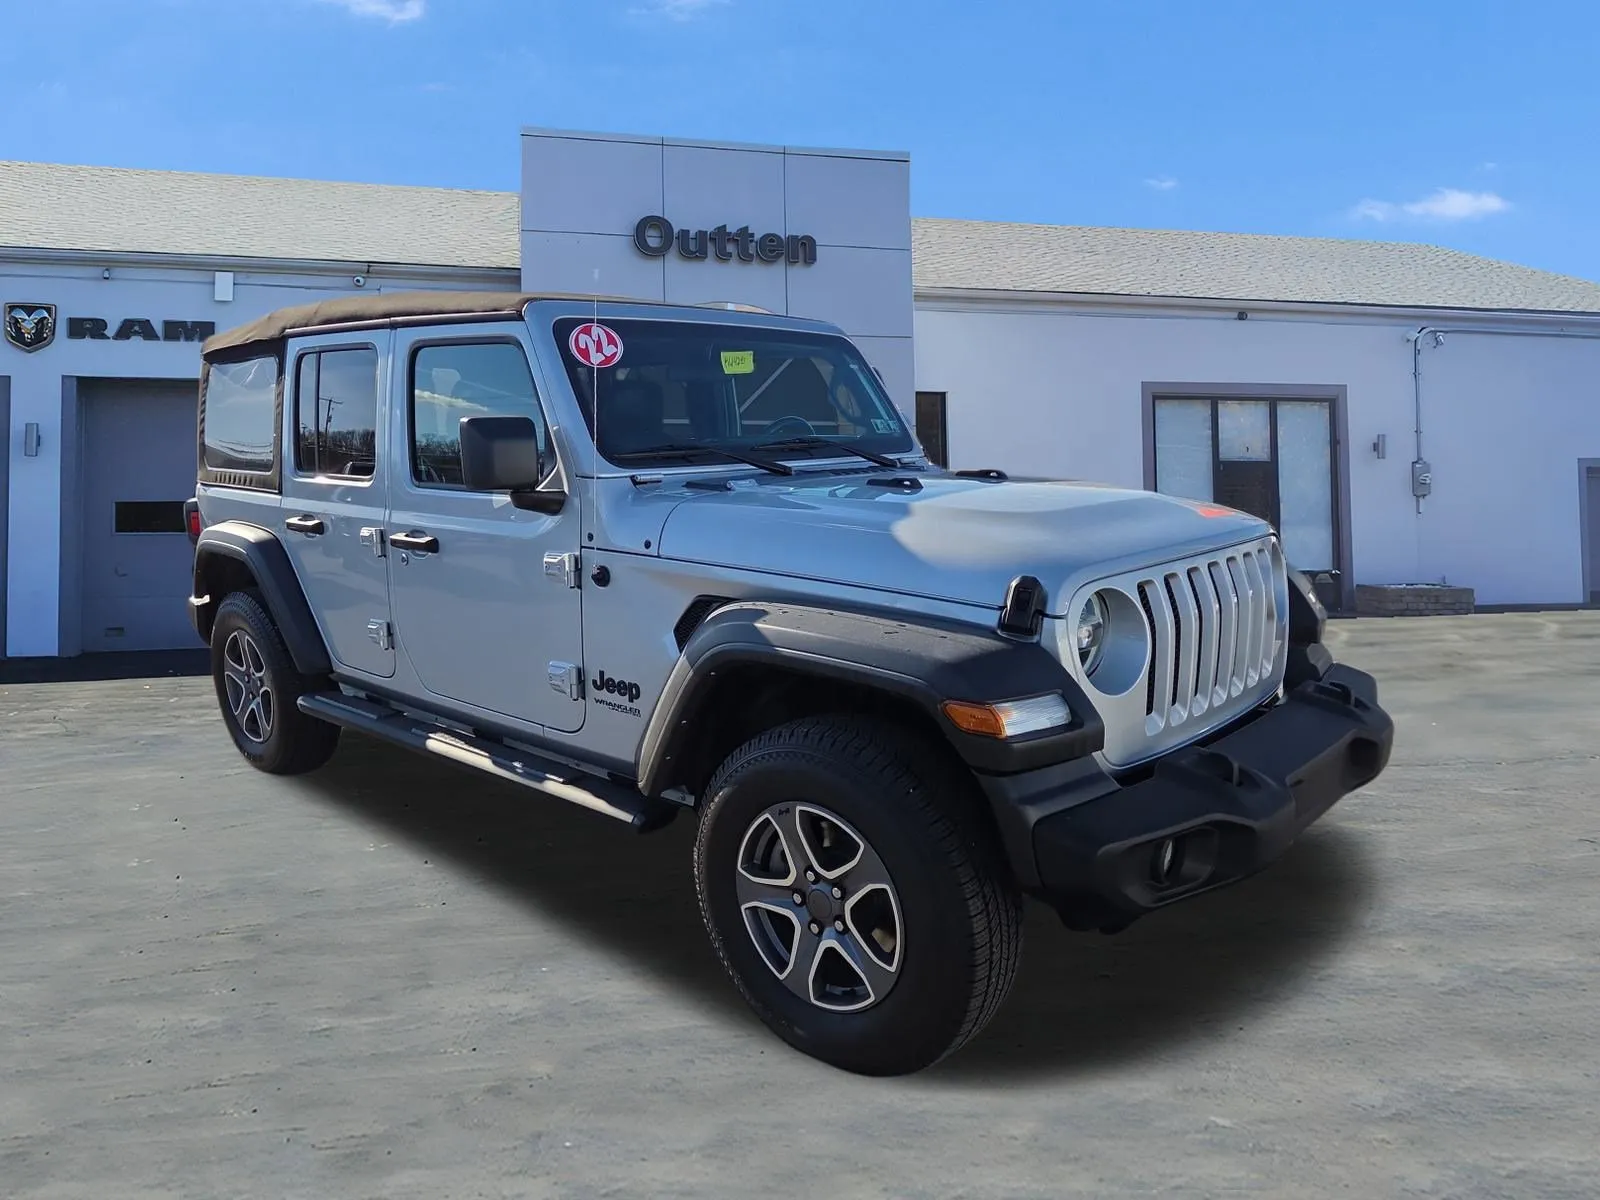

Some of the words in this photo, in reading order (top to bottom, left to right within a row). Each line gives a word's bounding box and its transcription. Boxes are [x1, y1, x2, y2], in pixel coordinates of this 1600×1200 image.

[634, 215, 817, 264] Outten
[67, 317, 215, 342] RAM
[578, 326, 618, 365] 22
[592, 669, 640, 703] Jeep
[594, 697, 641, 715] WRANGLER
